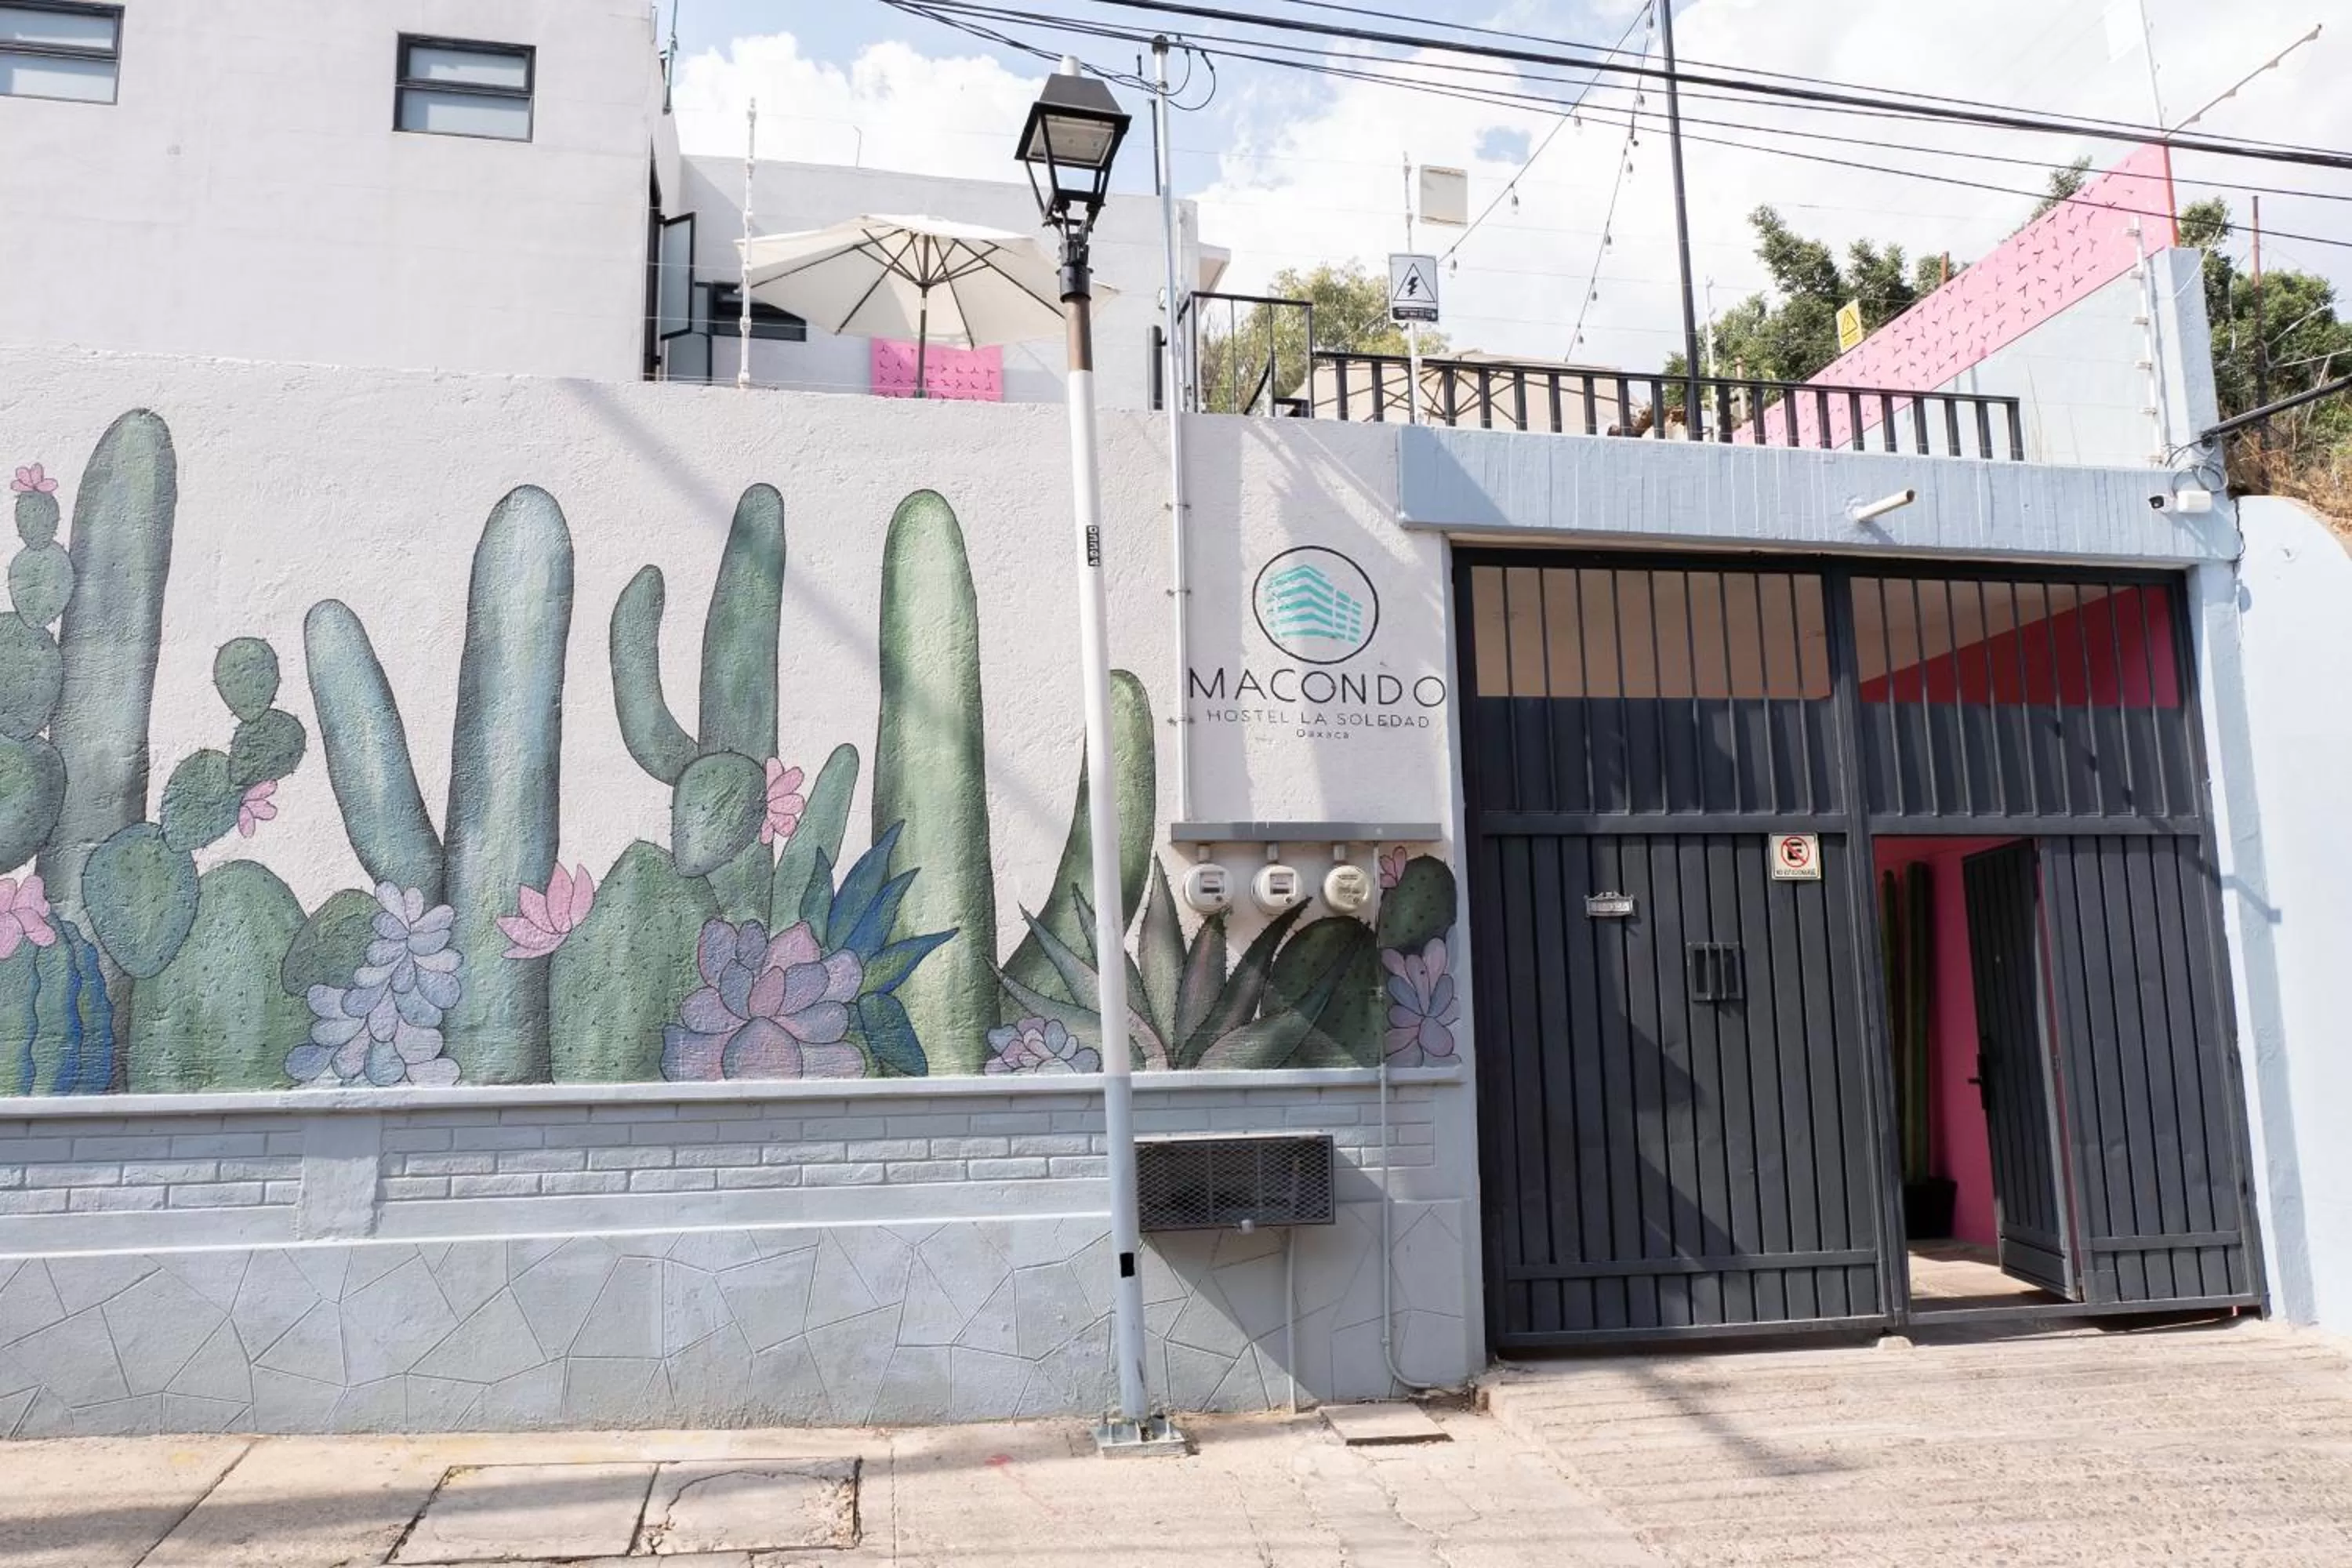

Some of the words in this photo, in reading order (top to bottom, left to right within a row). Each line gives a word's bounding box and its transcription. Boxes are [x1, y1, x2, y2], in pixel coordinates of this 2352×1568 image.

[1189, 667, 1446, 707] MACONDO
[1207, 710, 1289, 724] HOSTEL
[1301, 712, 1327, 725] LA
[1337, 713, 1429, 728] SOLEDAD
